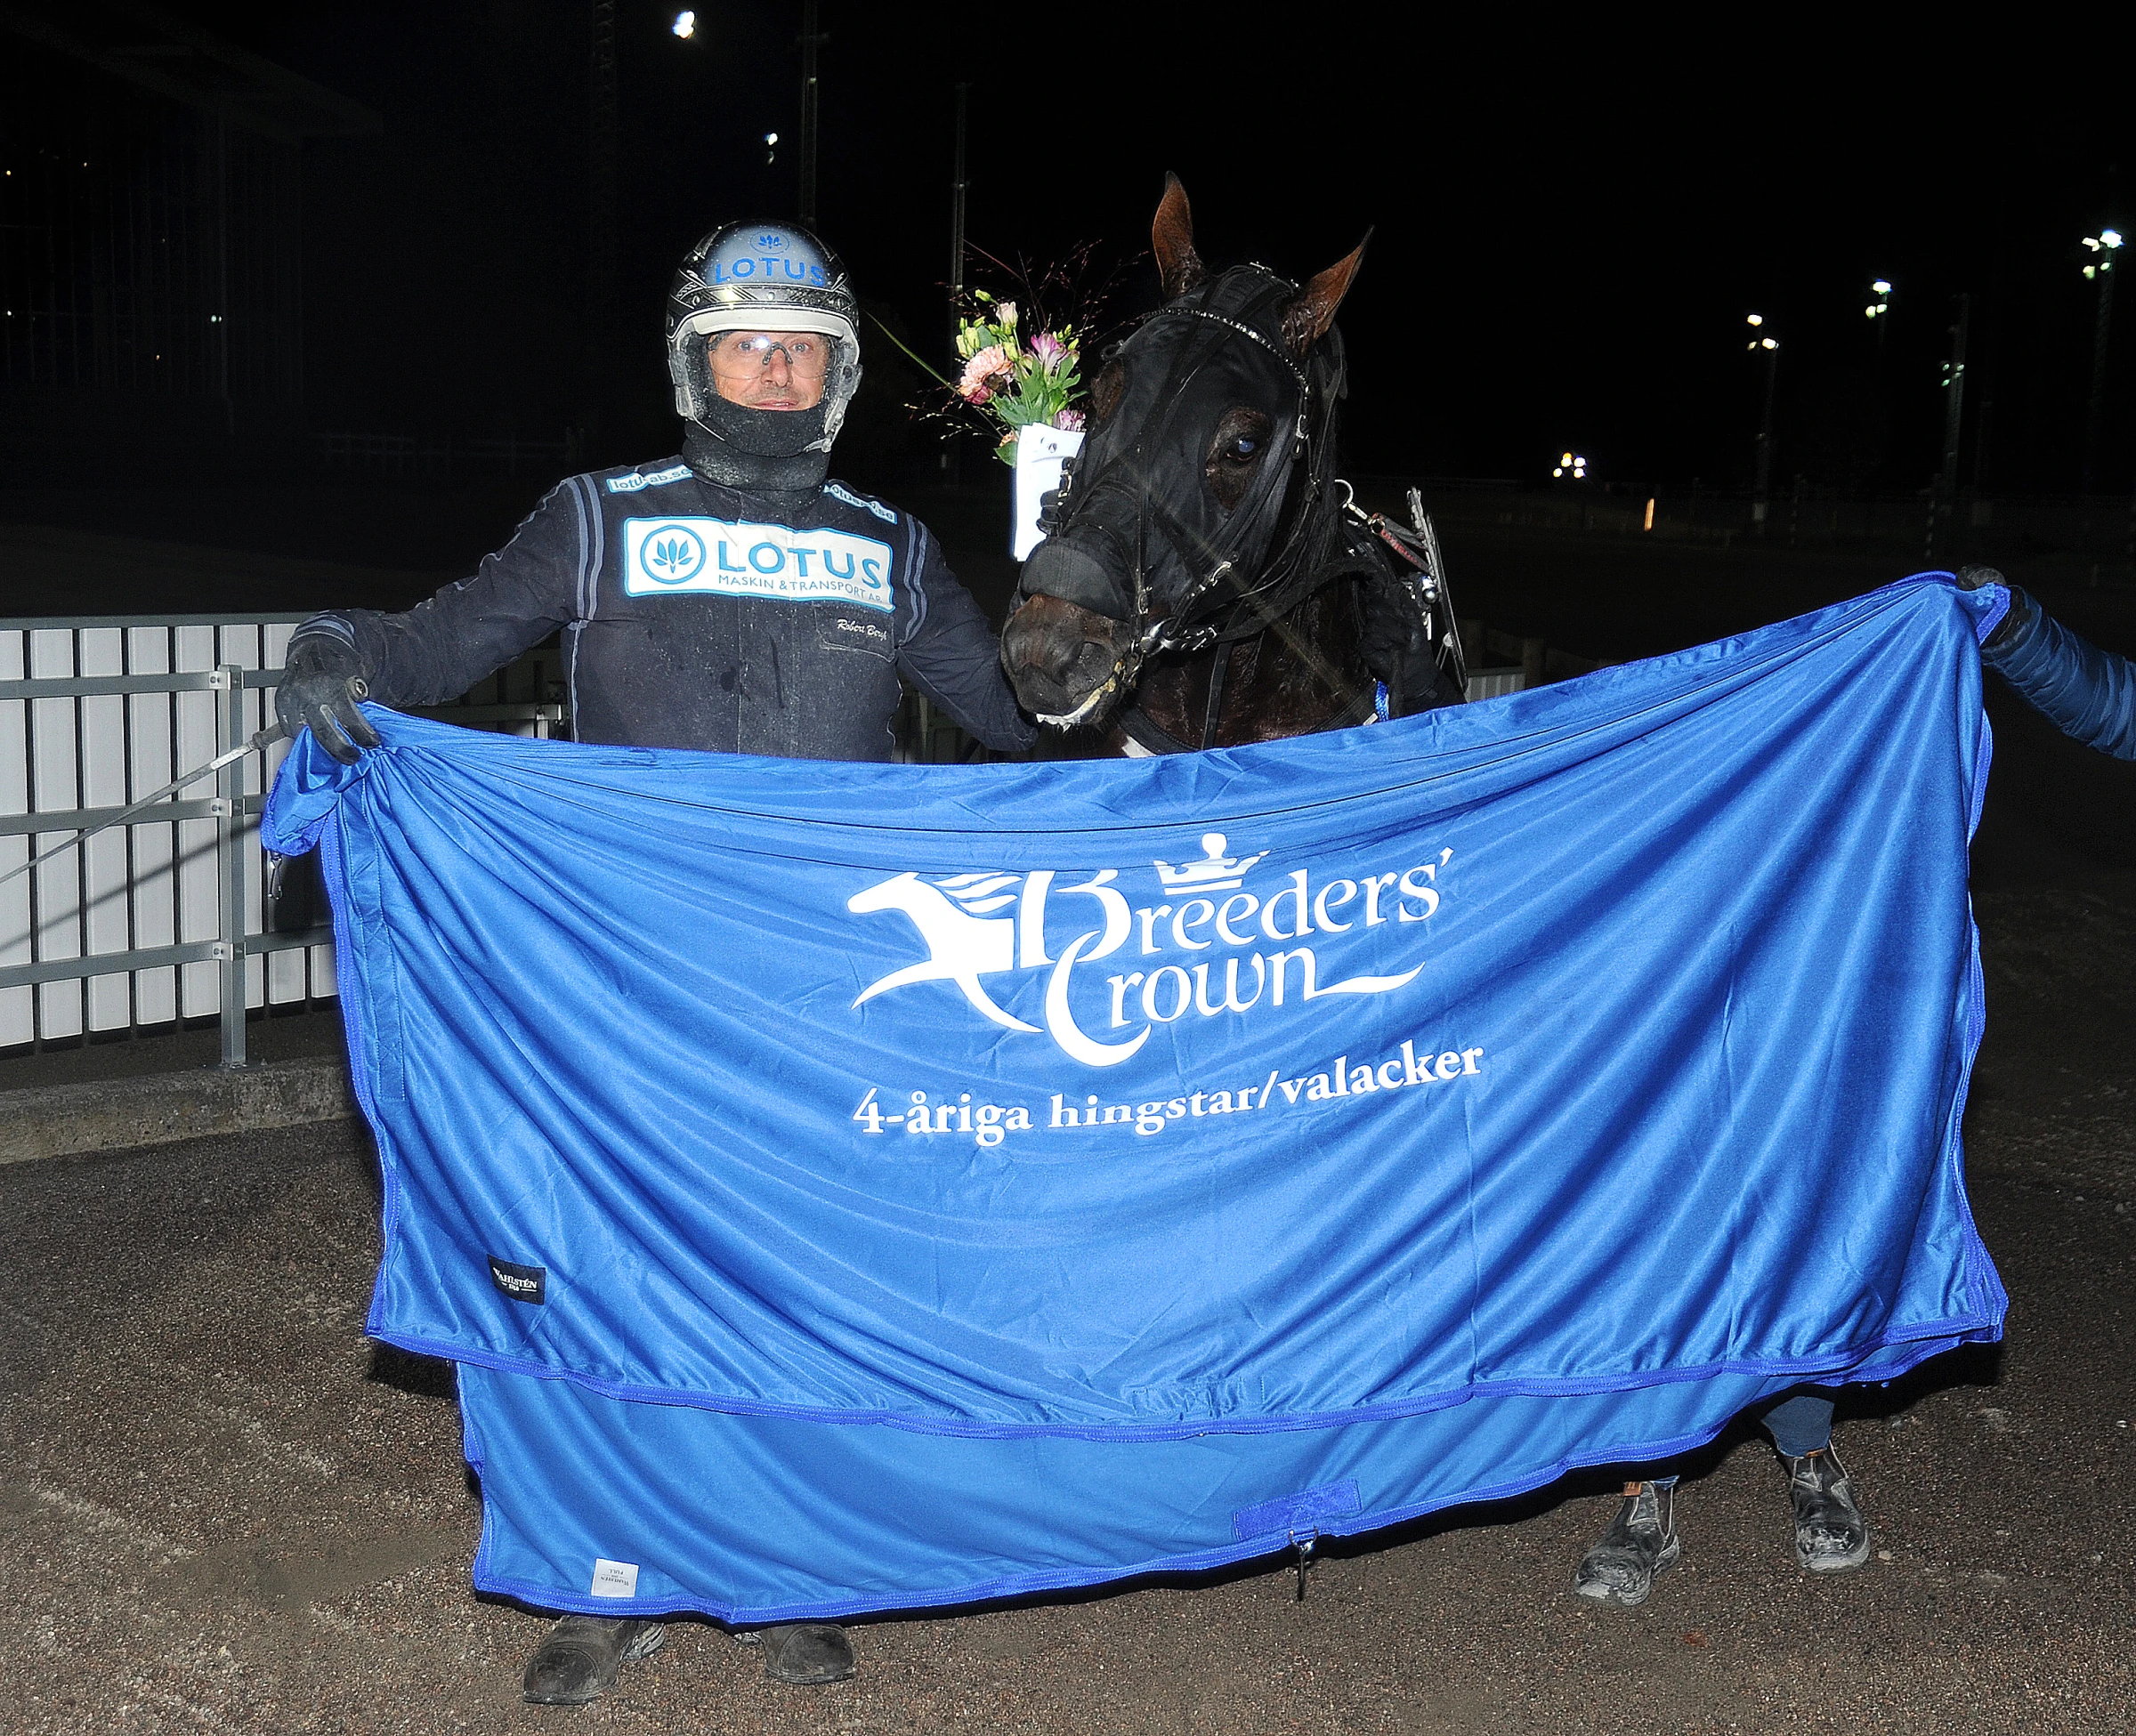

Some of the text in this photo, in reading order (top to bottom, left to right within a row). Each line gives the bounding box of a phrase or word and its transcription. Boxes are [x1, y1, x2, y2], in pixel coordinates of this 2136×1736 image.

[715, 256, 826, 287] LOTUS
[717, 540, 882, 590] LOTUS
[718, 574, 775, 590] MASKIN
[789, 580, 866, 600] TRANSPORT
[1044, 929, 1427, 1068] Crown
[852, 1086, 1035, 1147] 4-åriga
